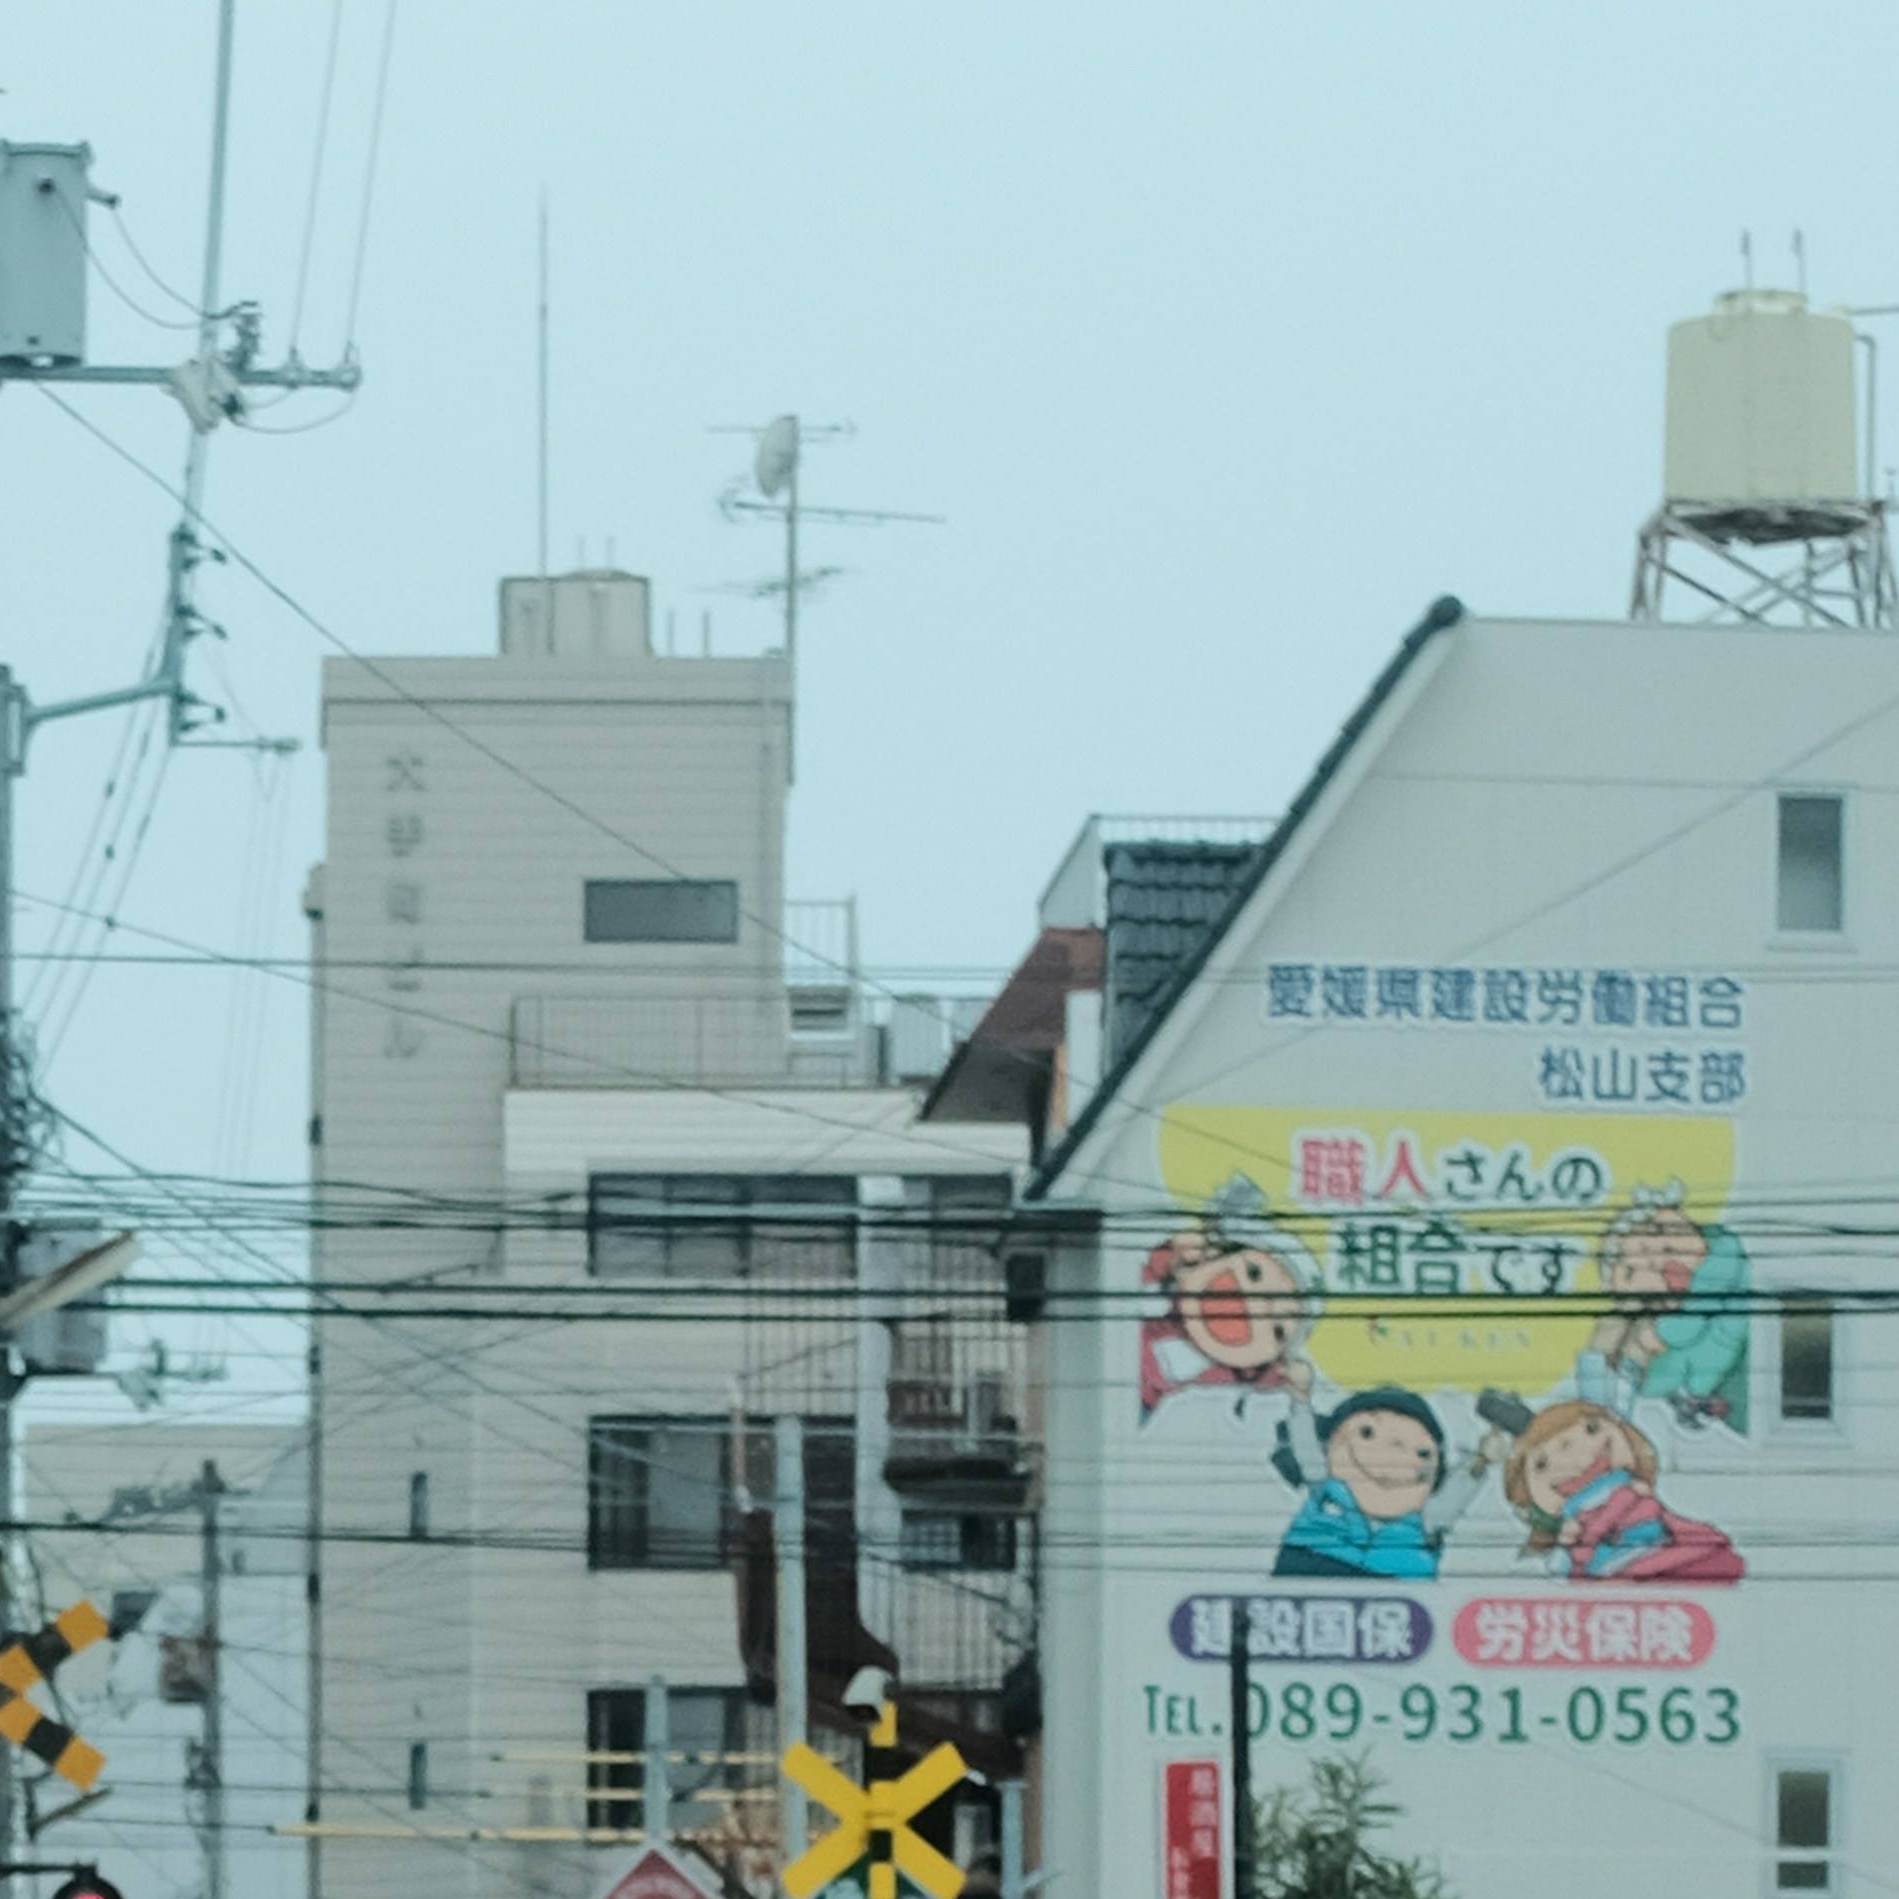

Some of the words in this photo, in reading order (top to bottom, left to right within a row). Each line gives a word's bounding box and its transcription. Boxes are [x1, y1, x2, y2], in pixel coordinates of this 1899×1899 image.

[1268, 964, 1743, 1028] 愛媛県建設労働組合
[1539, 1048, 1747, 1105] 松山支部
[1300, 1137, 1603, 1200] 職人さんの
[1336, 1221, 1576, 1296] 組合です
[1191, 1600, 1412, 1660] 建設国保
[1474, 1602, 1694, 1663] 労災保険
